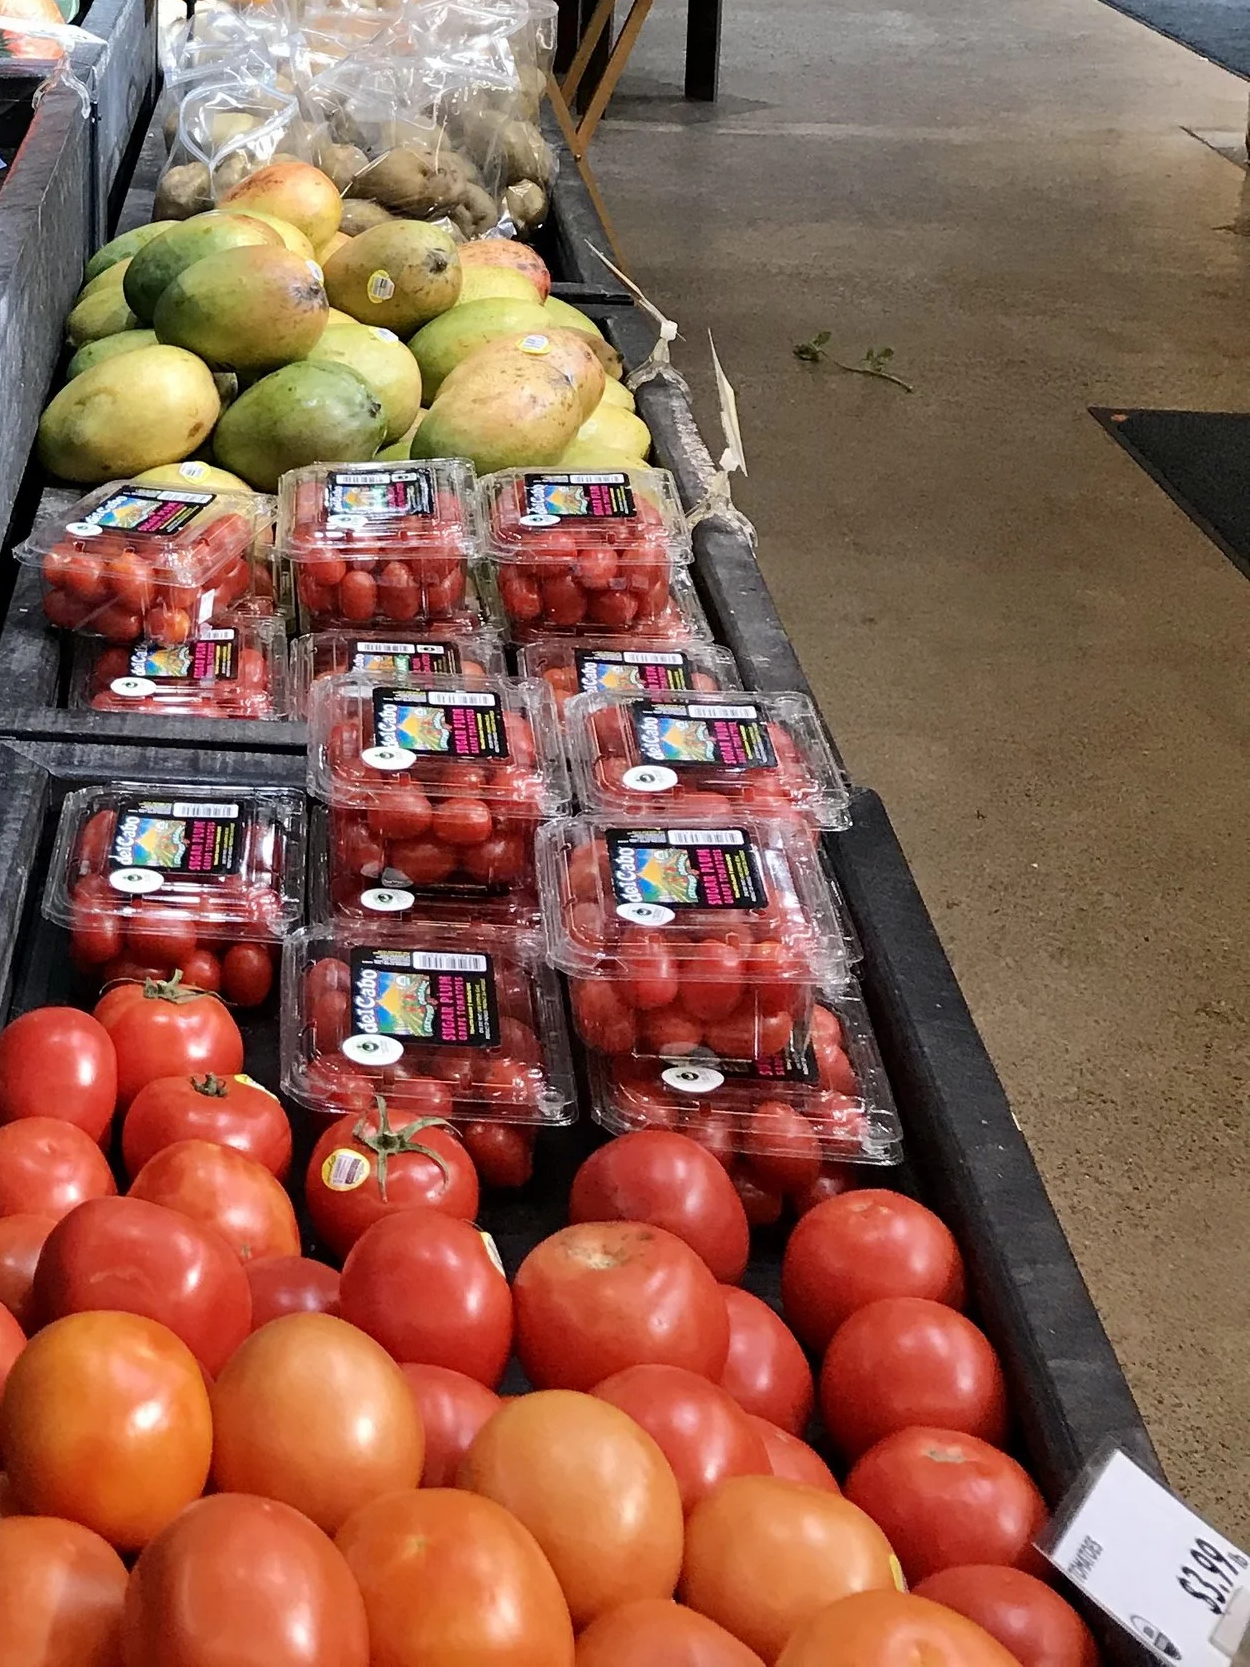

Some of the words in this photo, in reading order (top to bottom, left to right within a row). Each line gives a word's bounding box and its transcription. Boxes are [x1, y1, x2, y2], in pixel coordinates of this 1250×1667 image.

[696, 849, 715, 872] PLUM
[702, 875, 723, 905] SUGAR
[439, 976, 454, 1003] PLUM
[455, 976, 466, 1015] TOMATOES
[441, 1006, 457, 1041] SUGAR
[457, 1016, 468, 1041] GRAPE
[1067, 1535, 1103, 1583] TOMATOES
[1177, 1537, 1239, 1615] $3.99
